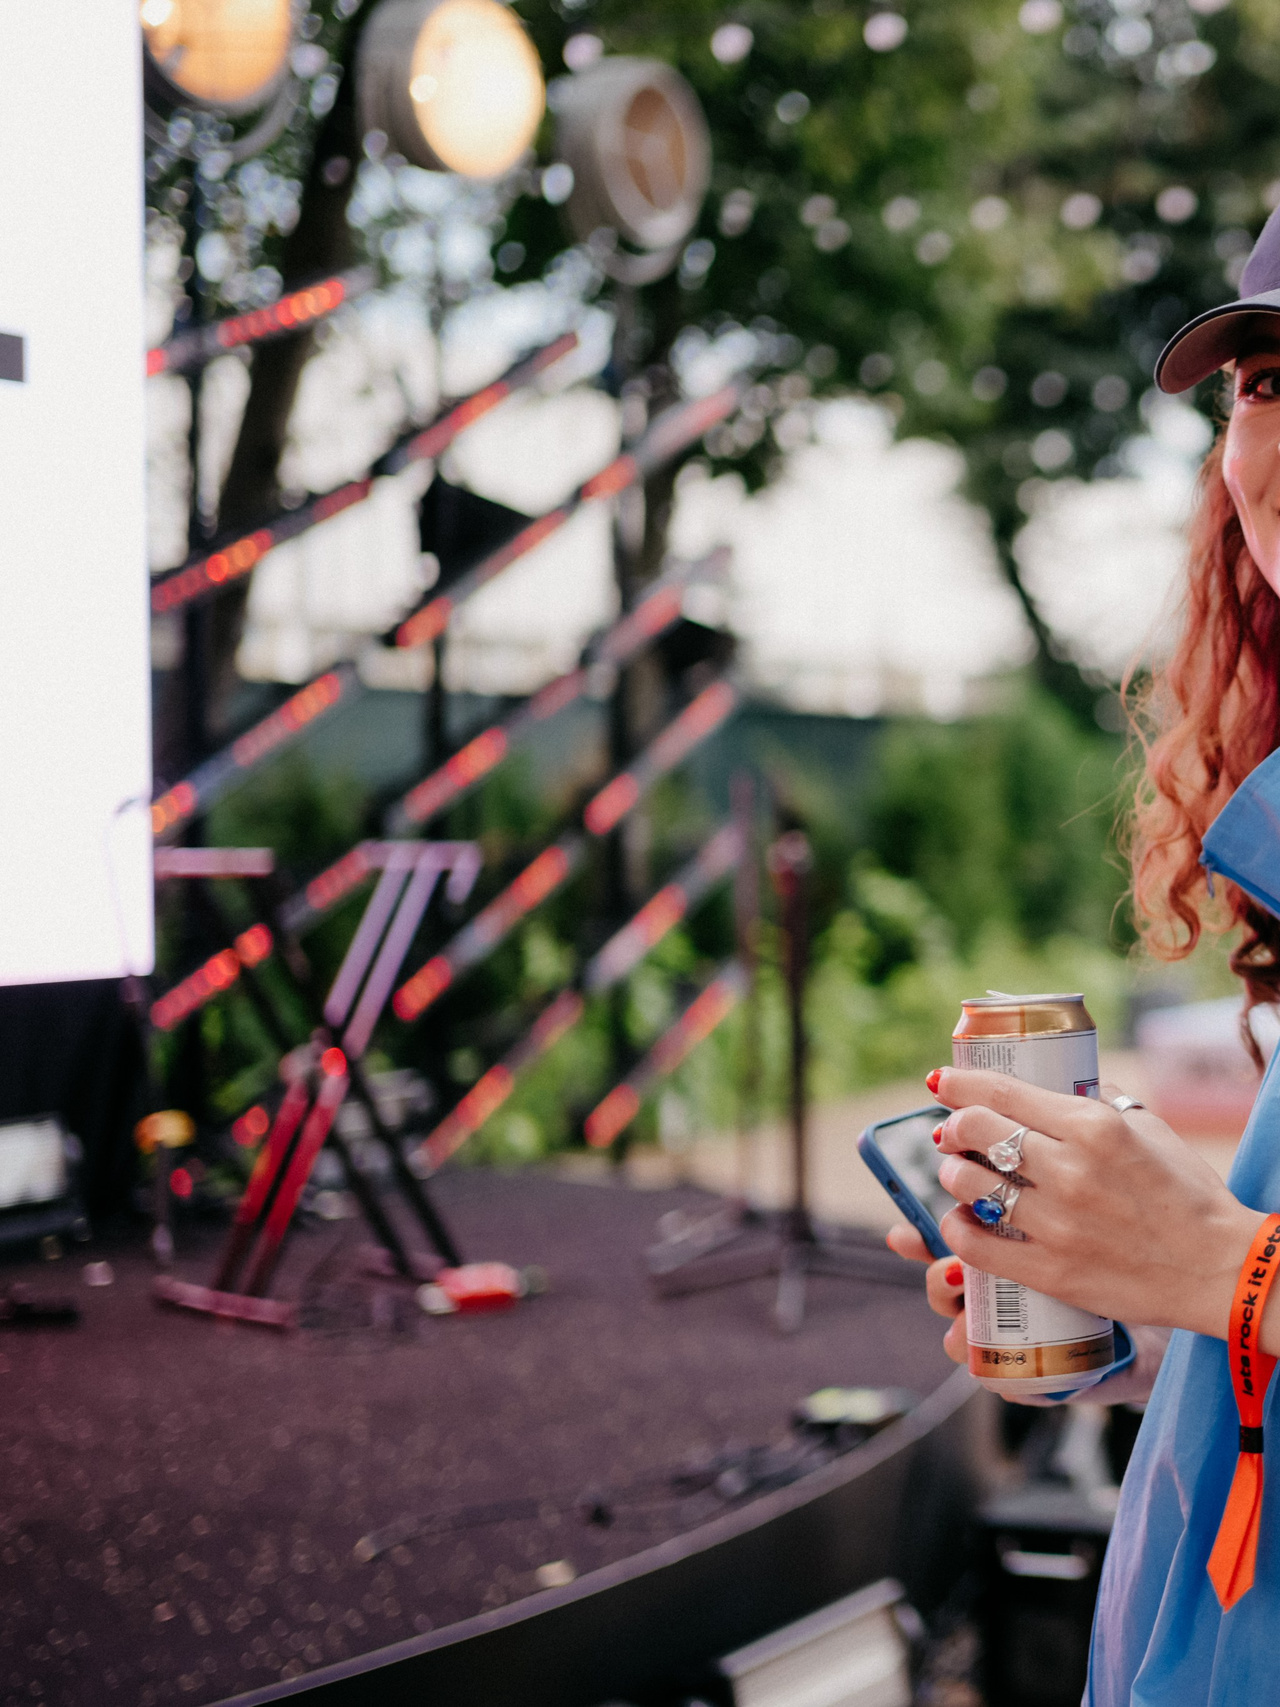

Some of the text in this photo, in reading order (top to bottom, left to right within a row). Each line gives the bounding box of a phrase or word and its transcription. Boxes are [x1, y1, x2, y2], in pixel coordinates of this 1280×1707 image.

[1248, 1267, 1267, 1287] it
[1239, 1292, 1258, 1350] rock
[1240, 1355, 1254, 1397] lets
